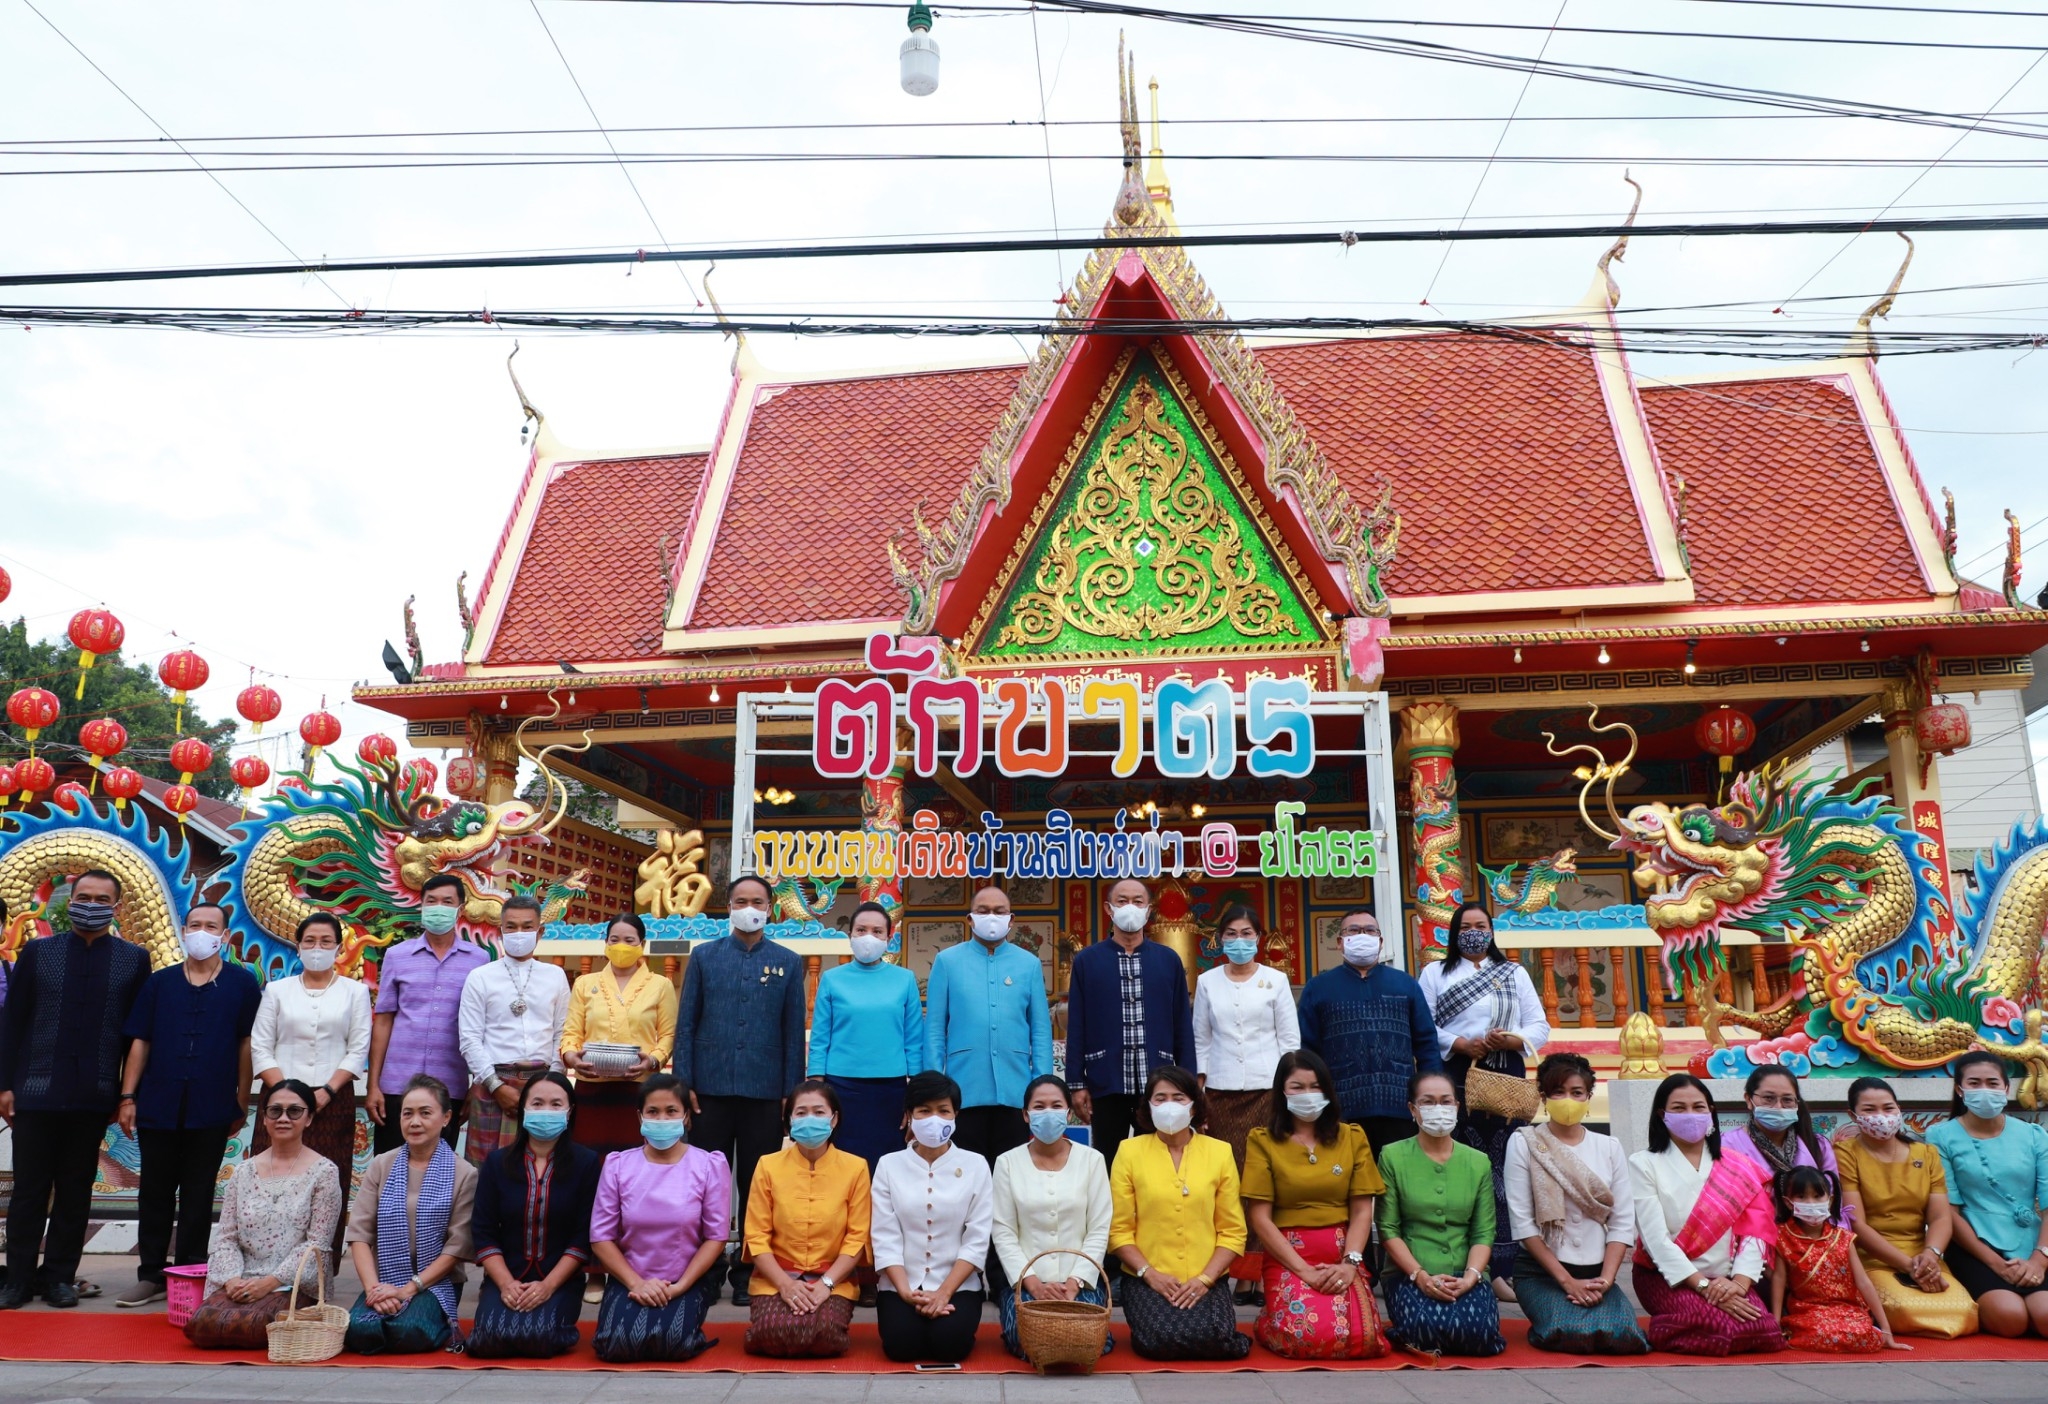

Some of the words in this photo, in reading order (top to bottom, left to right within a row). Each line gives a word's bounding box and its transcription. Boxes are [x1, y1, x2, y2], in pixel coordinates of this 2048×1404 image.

[813, 631, 1317, 779] ตักบาตร
[1201, 822, 1239, 878] @
[1258, 801, 1378, 878] ยโสธร
